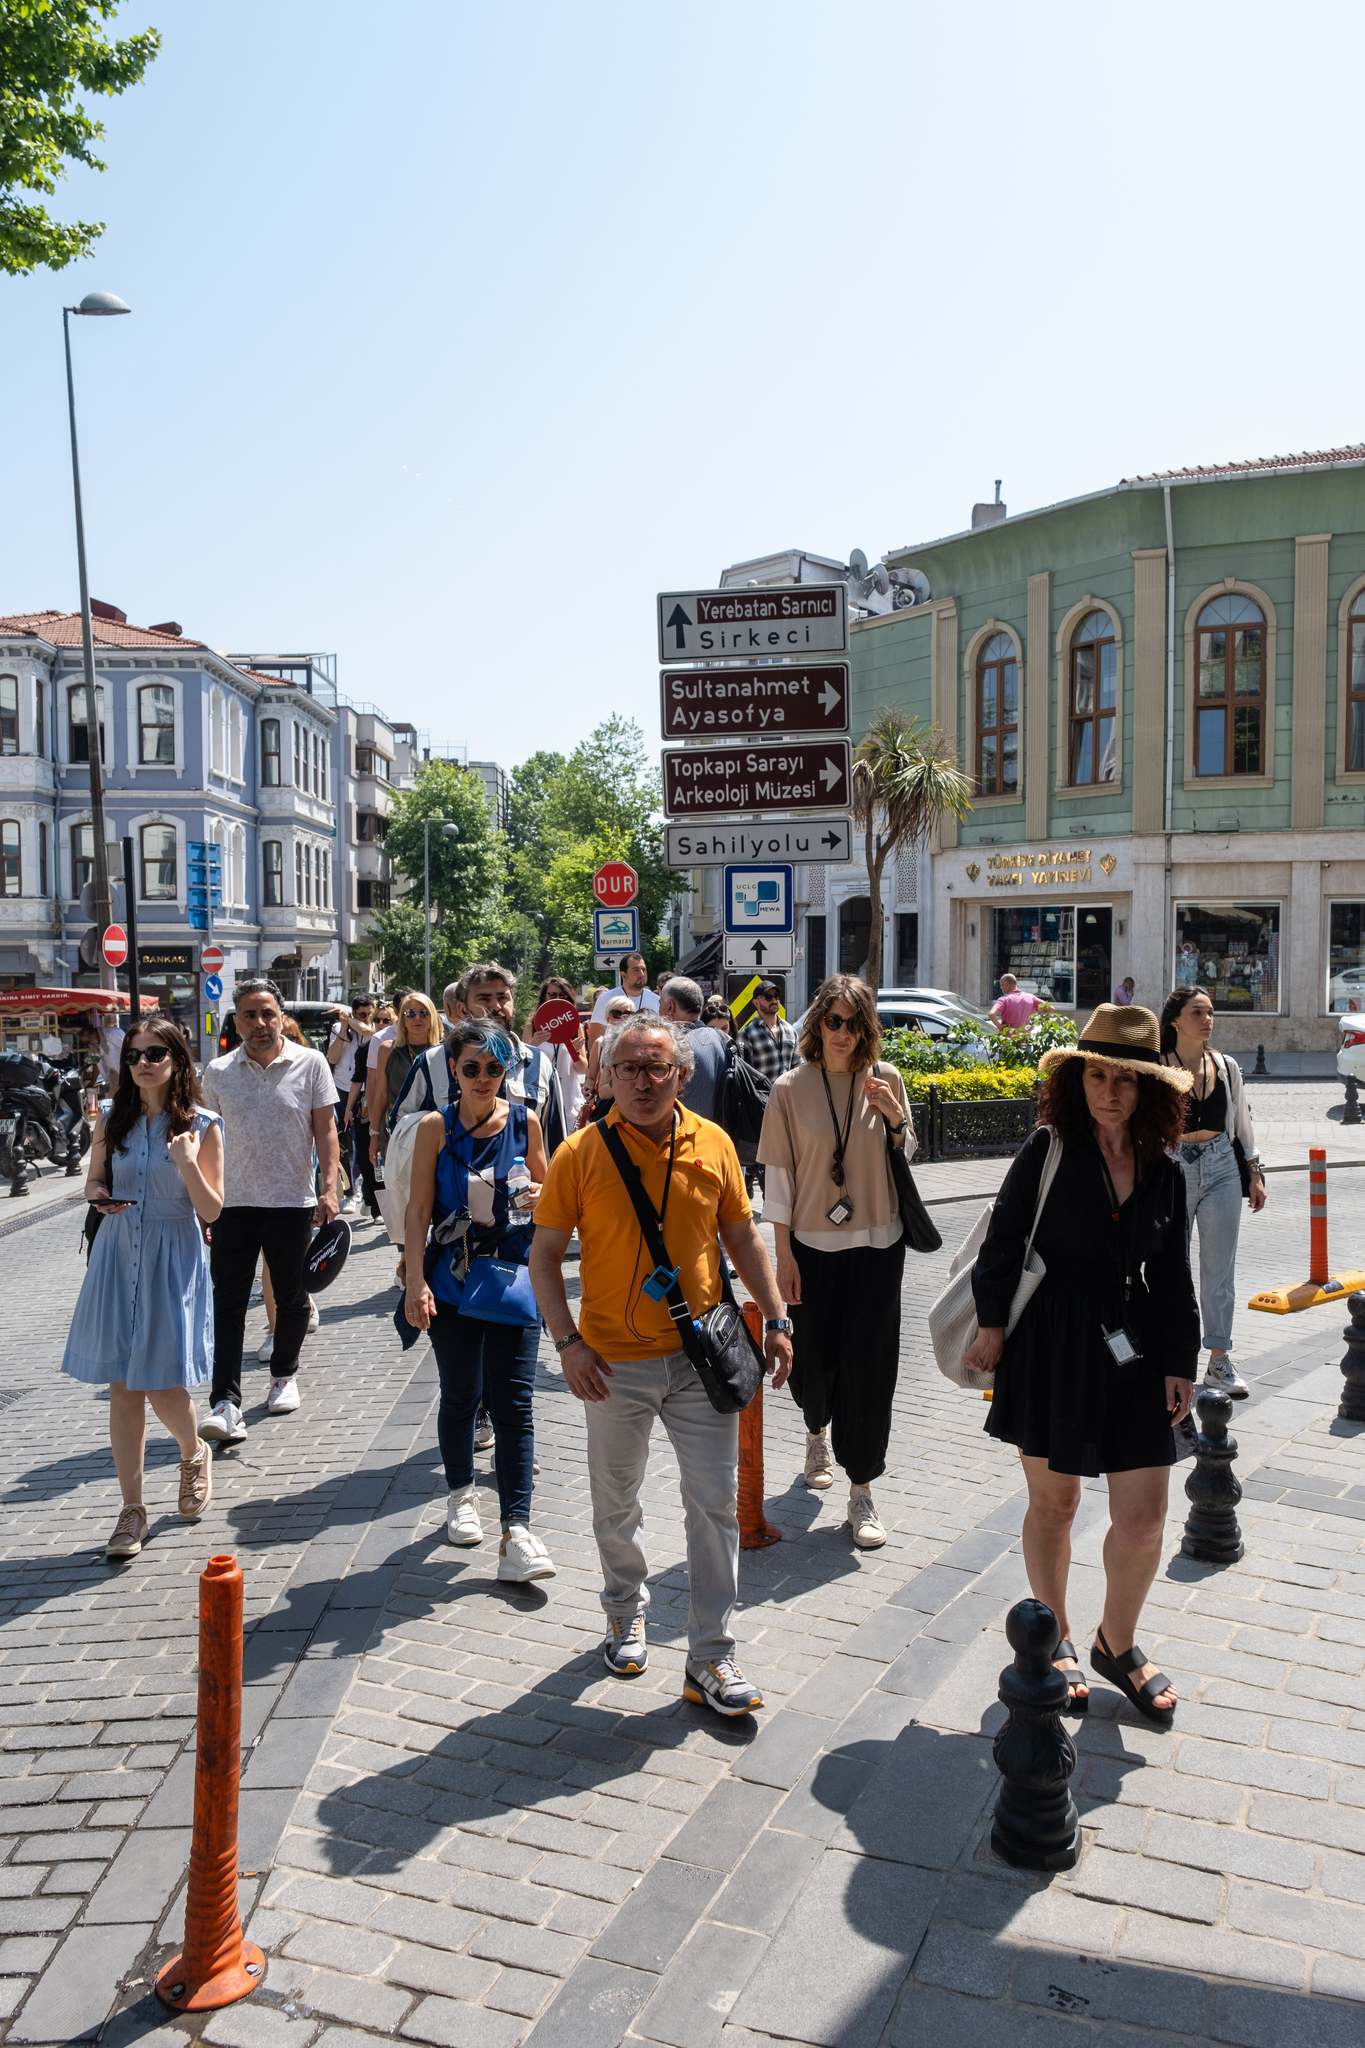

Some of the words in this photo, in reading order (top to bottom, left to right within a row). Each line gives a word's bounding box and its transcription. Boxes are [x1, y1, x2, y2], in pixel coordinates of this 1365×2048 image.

[700, 599, 777, 620] Yerebatan
[781, 596, 833, 616] Sarnıcı
[700, 626, 810, 650] Sirkeci
[671, 676, 810, 700] Sultanahmet
[671, 704, 785, 730] Ayasofya
[671, 756, 741, 781] Topkapı
[746, 754, 804, 775] Sarayı
[673, 783, 749, 806] Arkeoloji
[755, 780, 816, 801] Müzesi
[678, 833, 809, 859] Sahilyolu
[597, 875, 634, 894] DUR
[600, 938, 632, 946] Marmaray
[540, 1010, 575, 1031] HOME
